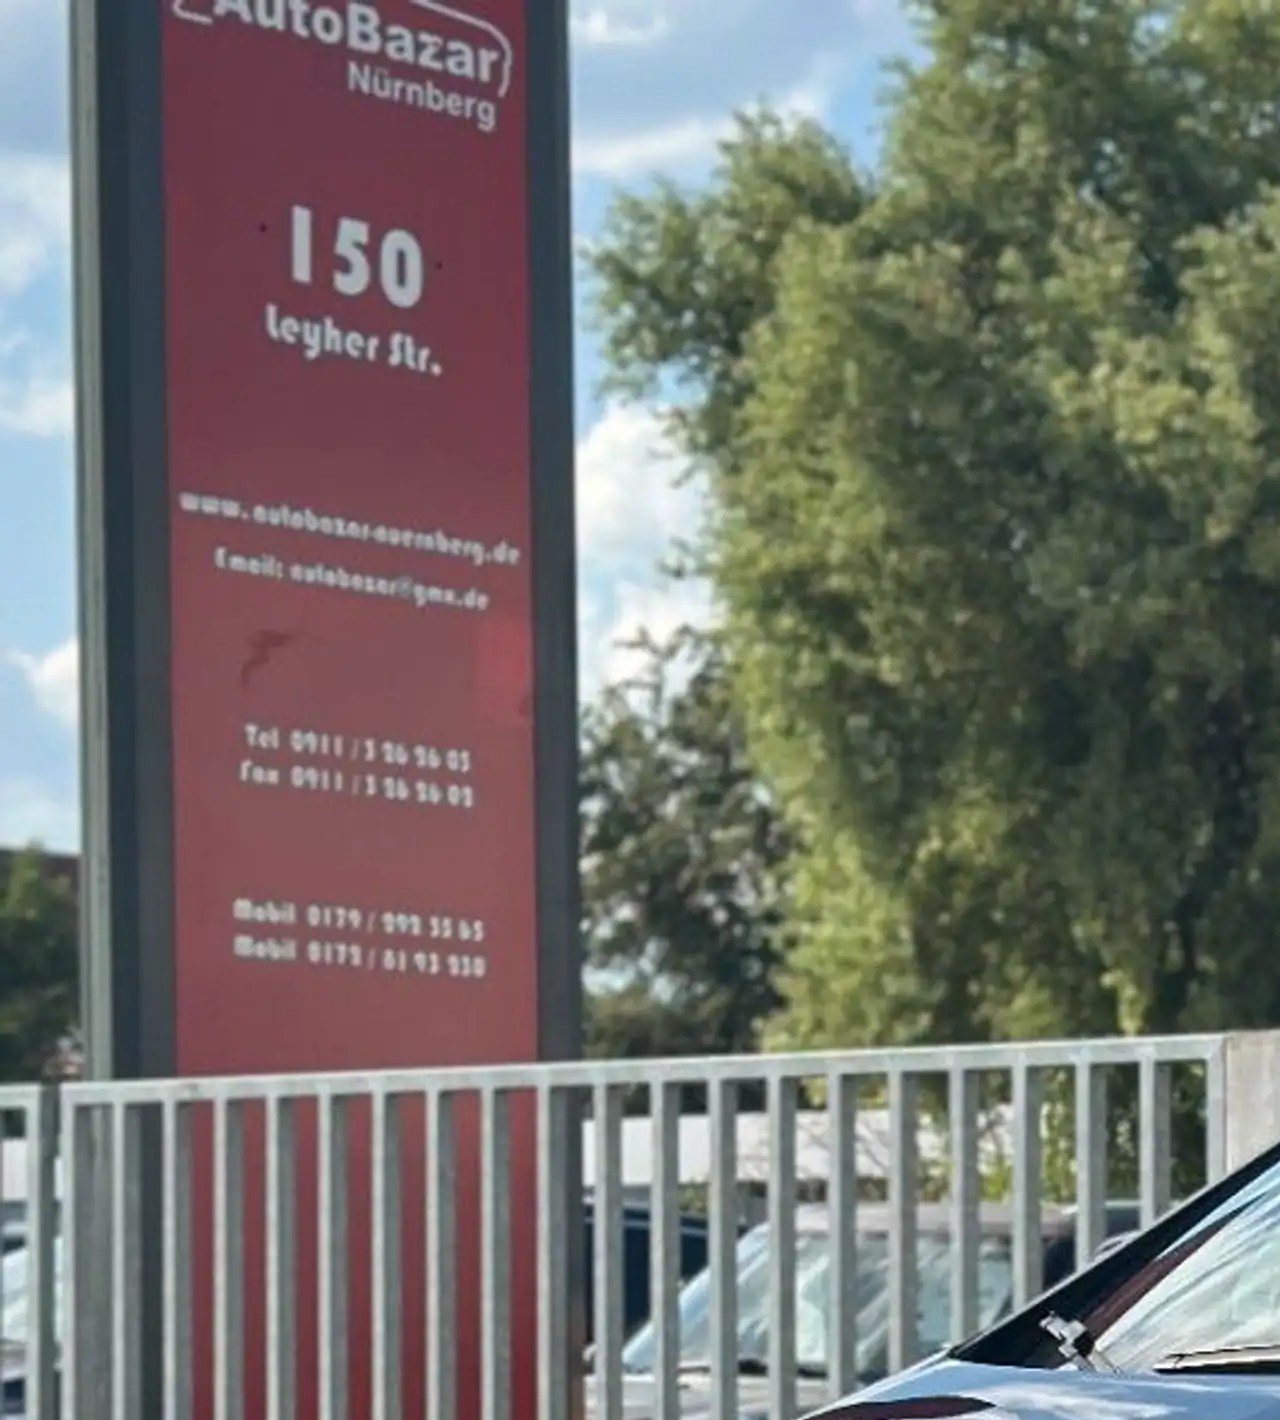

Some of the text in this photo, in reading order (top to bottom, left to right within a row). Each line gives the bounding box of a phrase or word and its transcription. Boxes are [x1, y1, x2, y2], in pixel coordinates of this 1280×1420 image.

[348, 61, 496, 132] Nürnberg
[292, 205, 424, 308] 150
[388, 332, 442, 376] Str.
[244, 723, 280, 750] Tel
[239, 759, 280, 785] Fax
[232, 897, 297, 924] Mobil
[233, 934, 297, 961] Mobil
